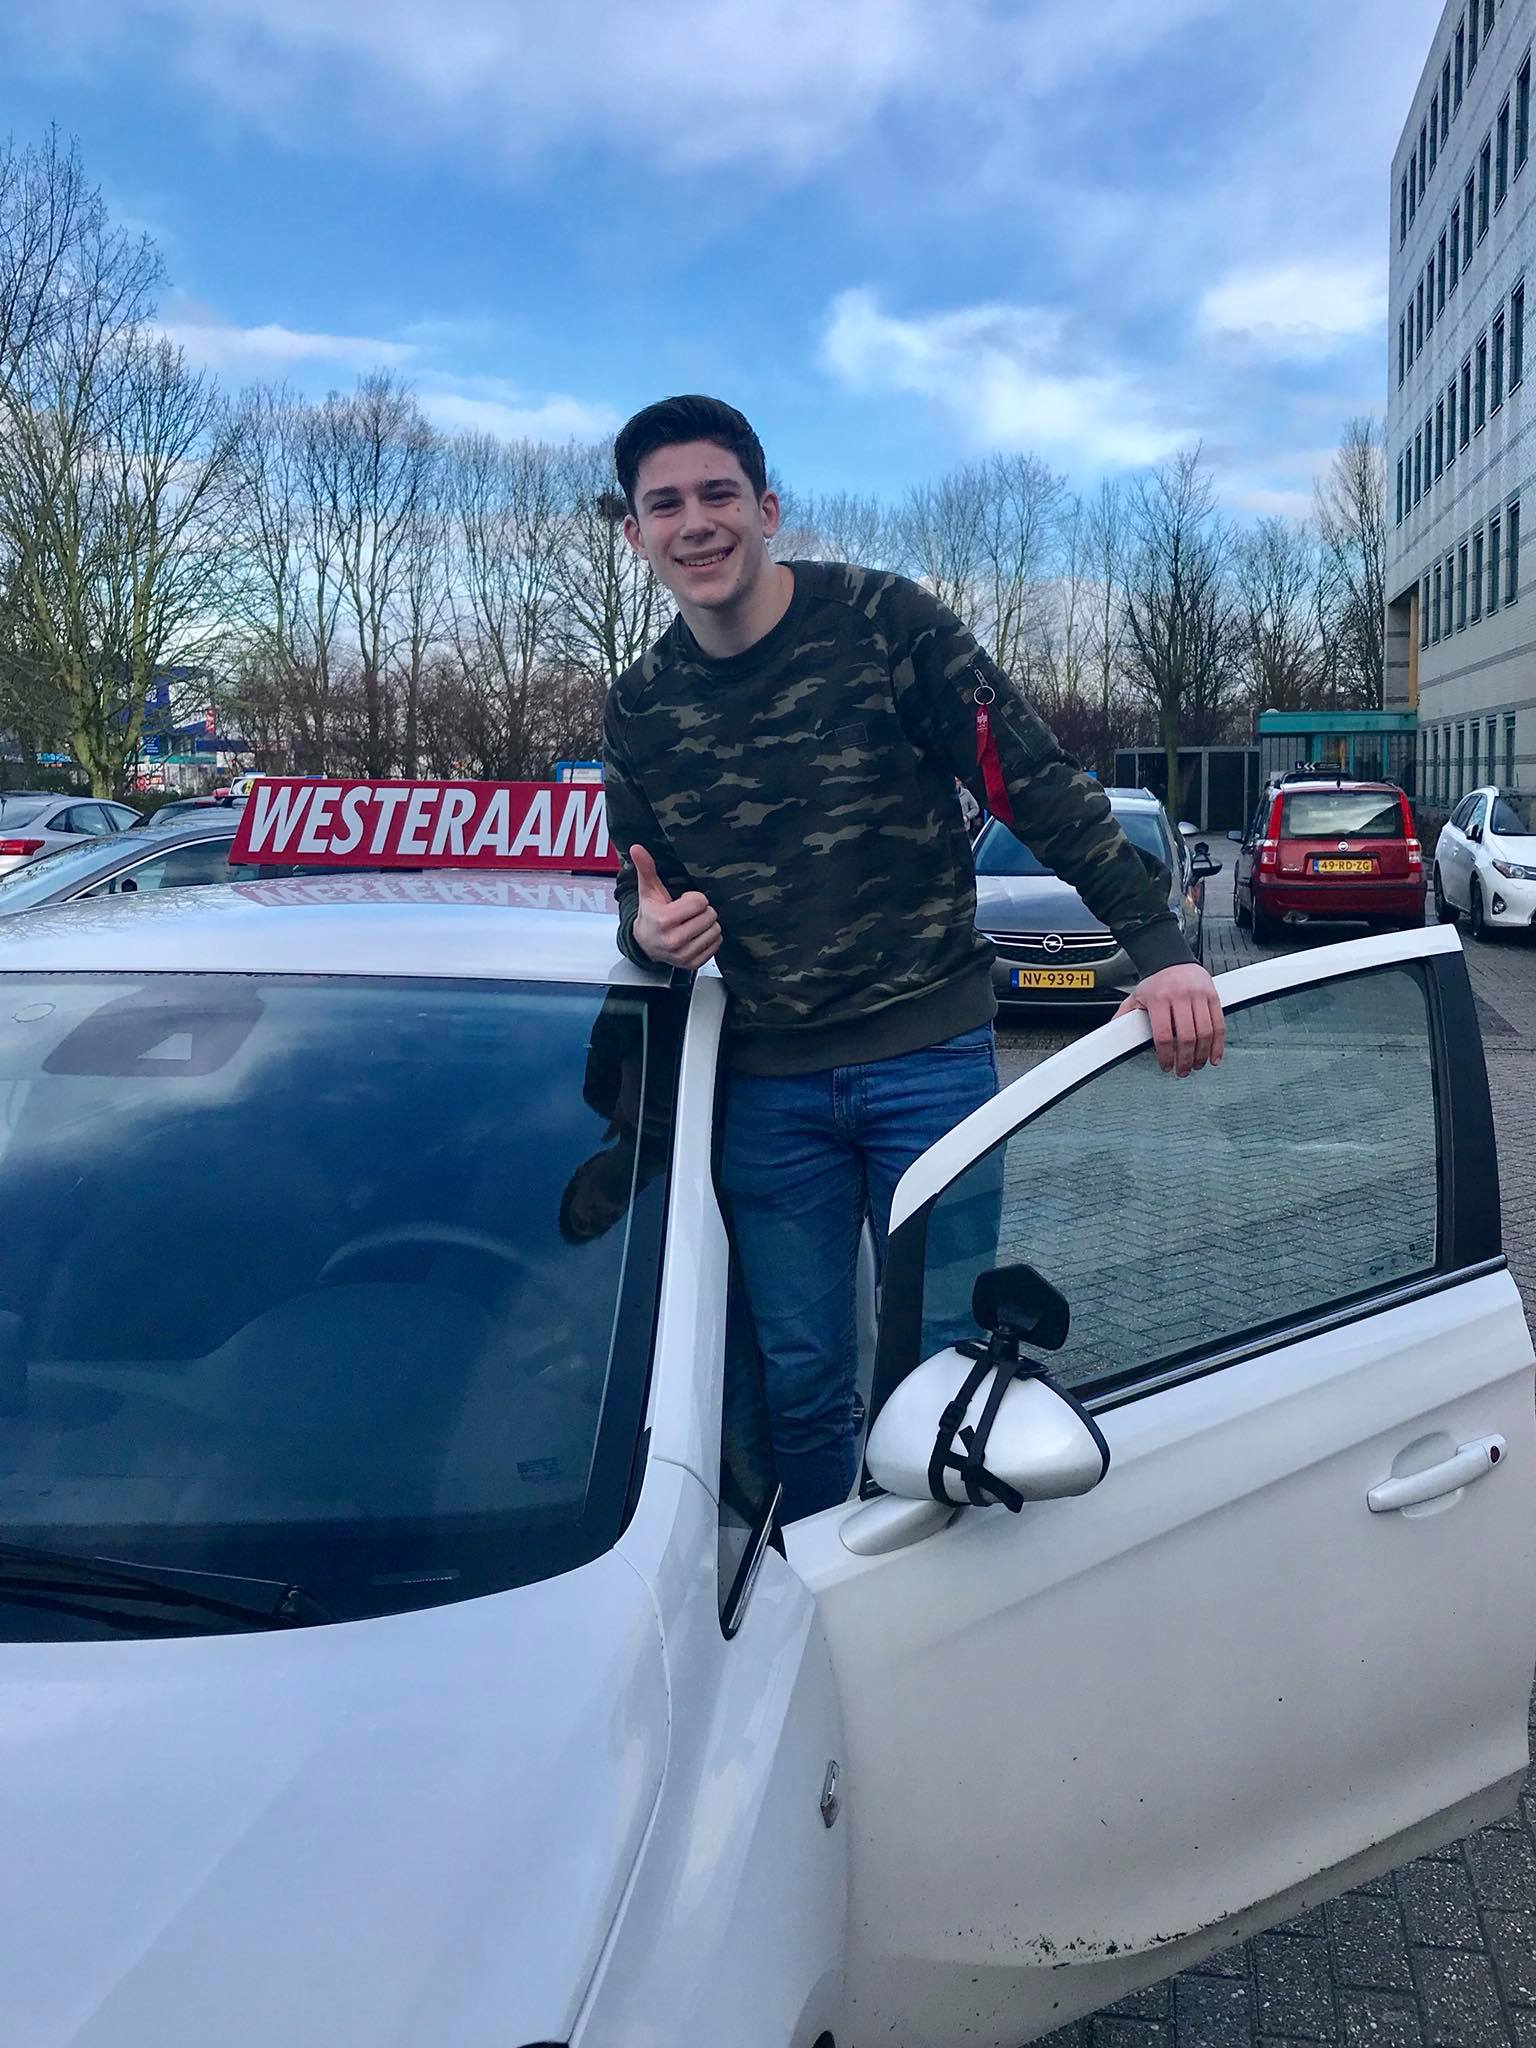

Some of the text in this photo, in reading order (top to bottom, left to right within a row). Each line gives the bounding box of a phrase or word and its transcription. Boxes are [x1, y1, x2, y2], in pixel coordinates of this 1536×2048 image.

[247, 786, 608, 858] WESTERAAM
[1321, 861, 1370, 871] 49-RD-ZG
[1023, 972, 1090, 986] NV-939-H
